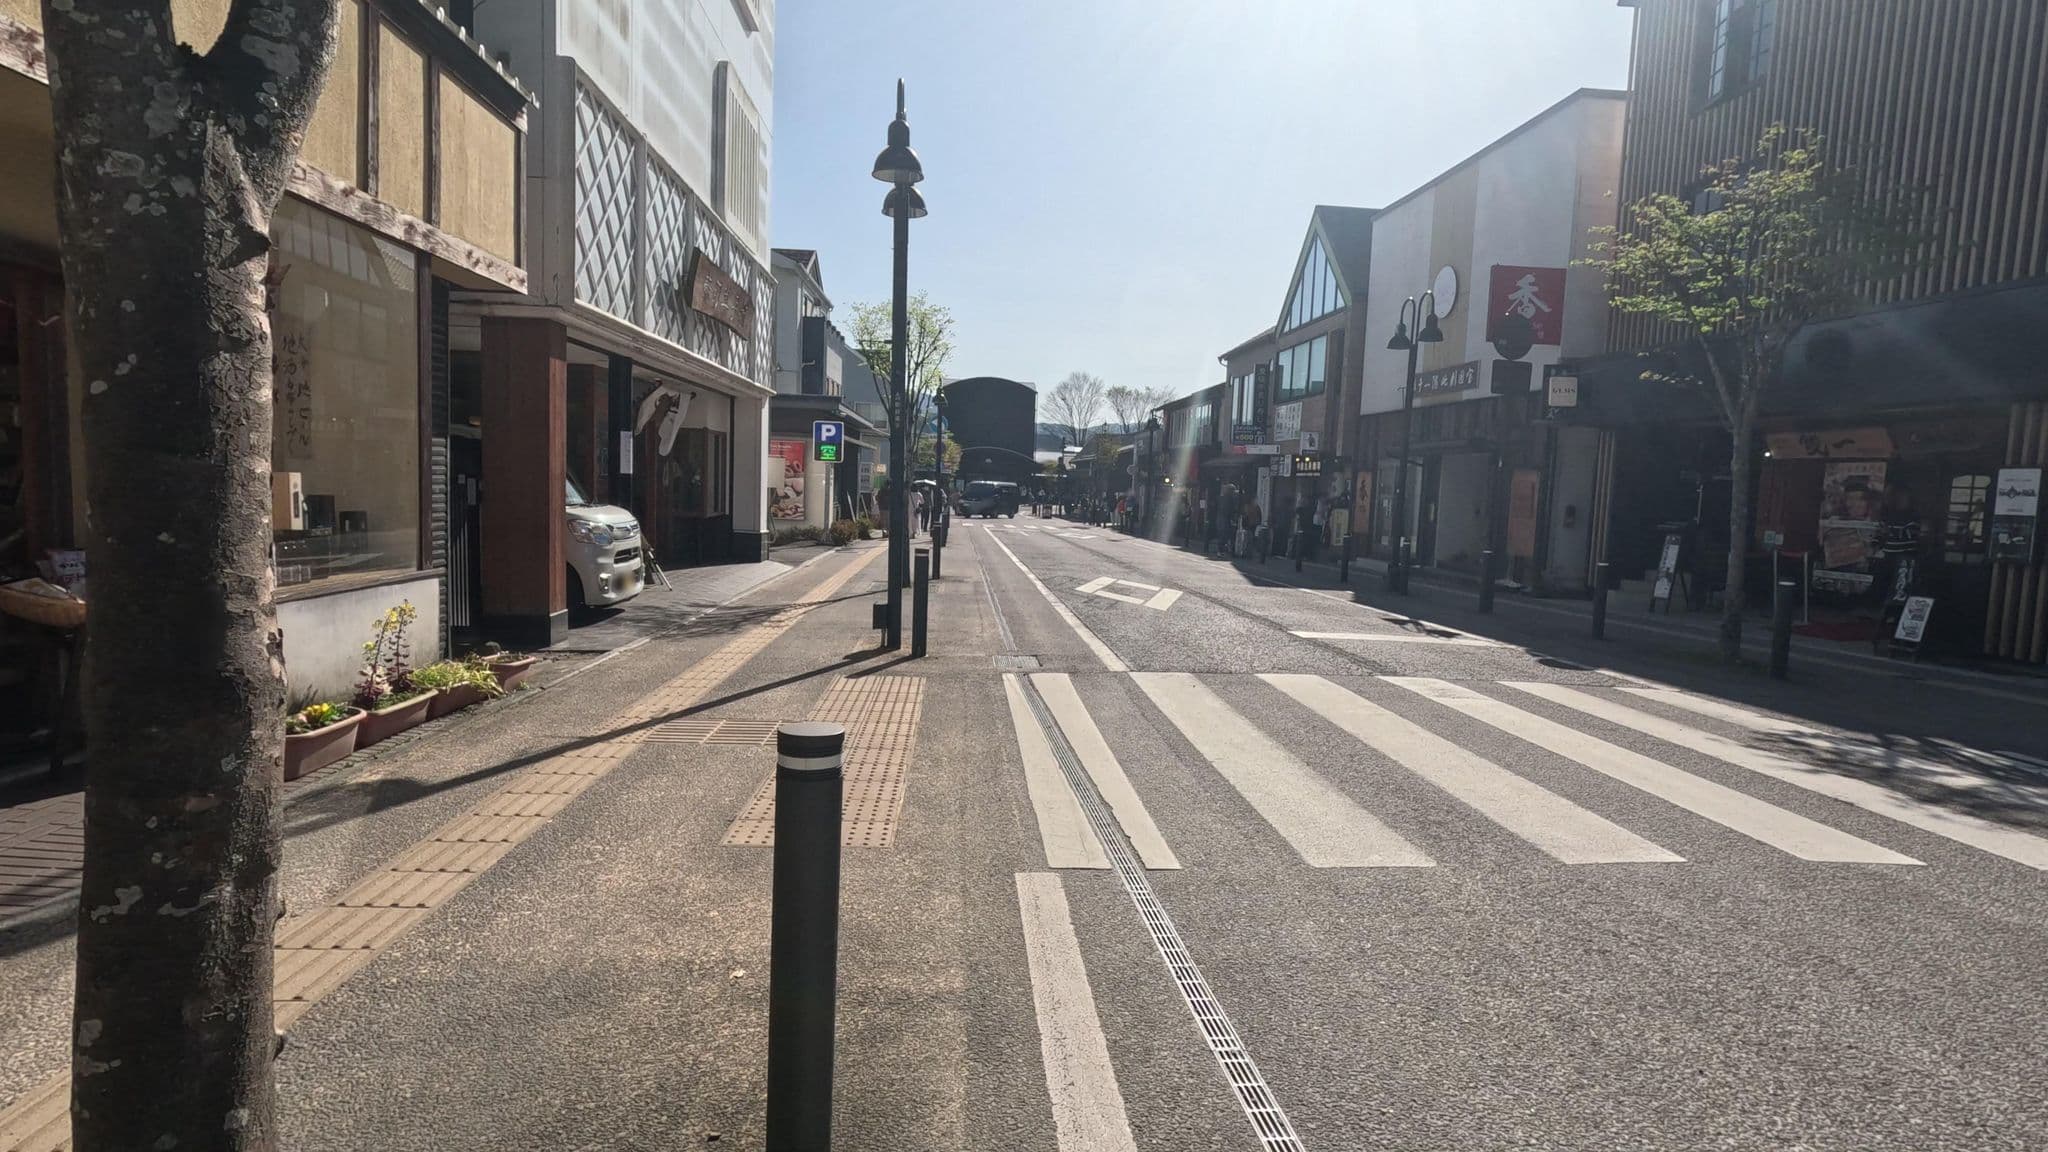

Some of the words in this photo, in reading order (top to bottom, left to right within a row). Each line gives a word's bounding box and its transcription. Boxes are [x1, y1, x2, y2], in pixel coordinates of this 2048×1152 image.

[1508, 272, 1553, 320] 香
[820, 423, 836, 441] P
[820, 445, 837, 460] 空
